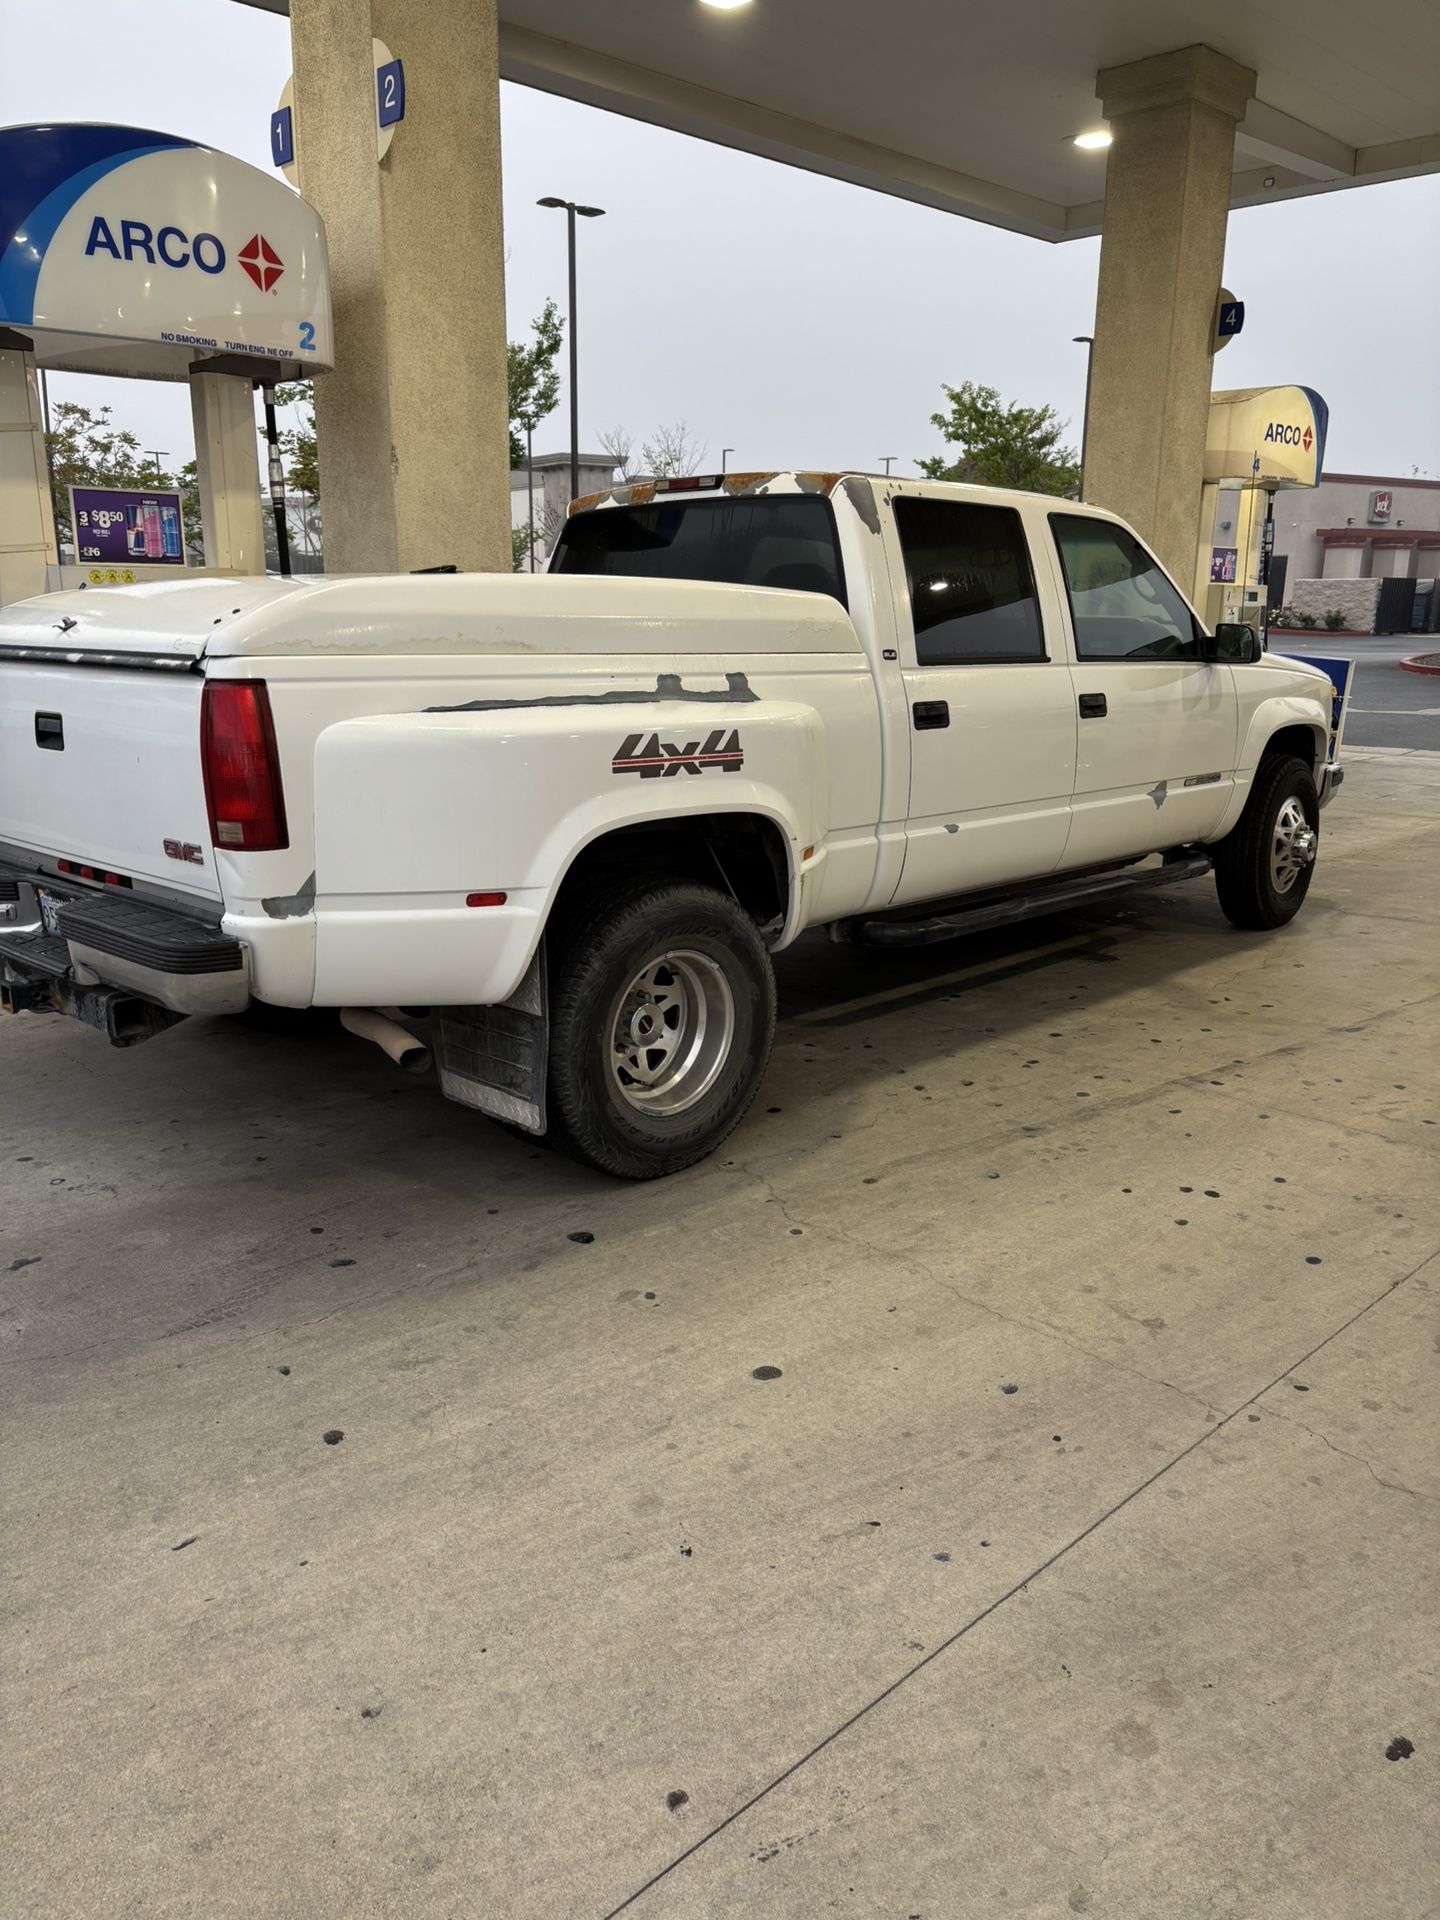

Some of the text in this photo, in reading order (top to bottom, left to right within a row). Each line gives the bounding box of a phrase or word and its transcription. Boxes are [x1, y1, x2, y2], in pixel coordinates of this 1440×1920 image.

[384, 74, 395, 108] 2
[276, 123, 283, 151] 1
[84, 215, 226, 275] ARCO
[1225, 308, 1236, 327] 4
[160, 331, 217, 347] NO SMOKING
[224, 340, 248, 352] TURN
[278, 348, 294, 358] OFF
[298, 321, 317, 351] 2
[1264, 422, 1301, 447] ARCO
[79, 511, 88, 523] 3
[163, 838, 204, 866] GMC
